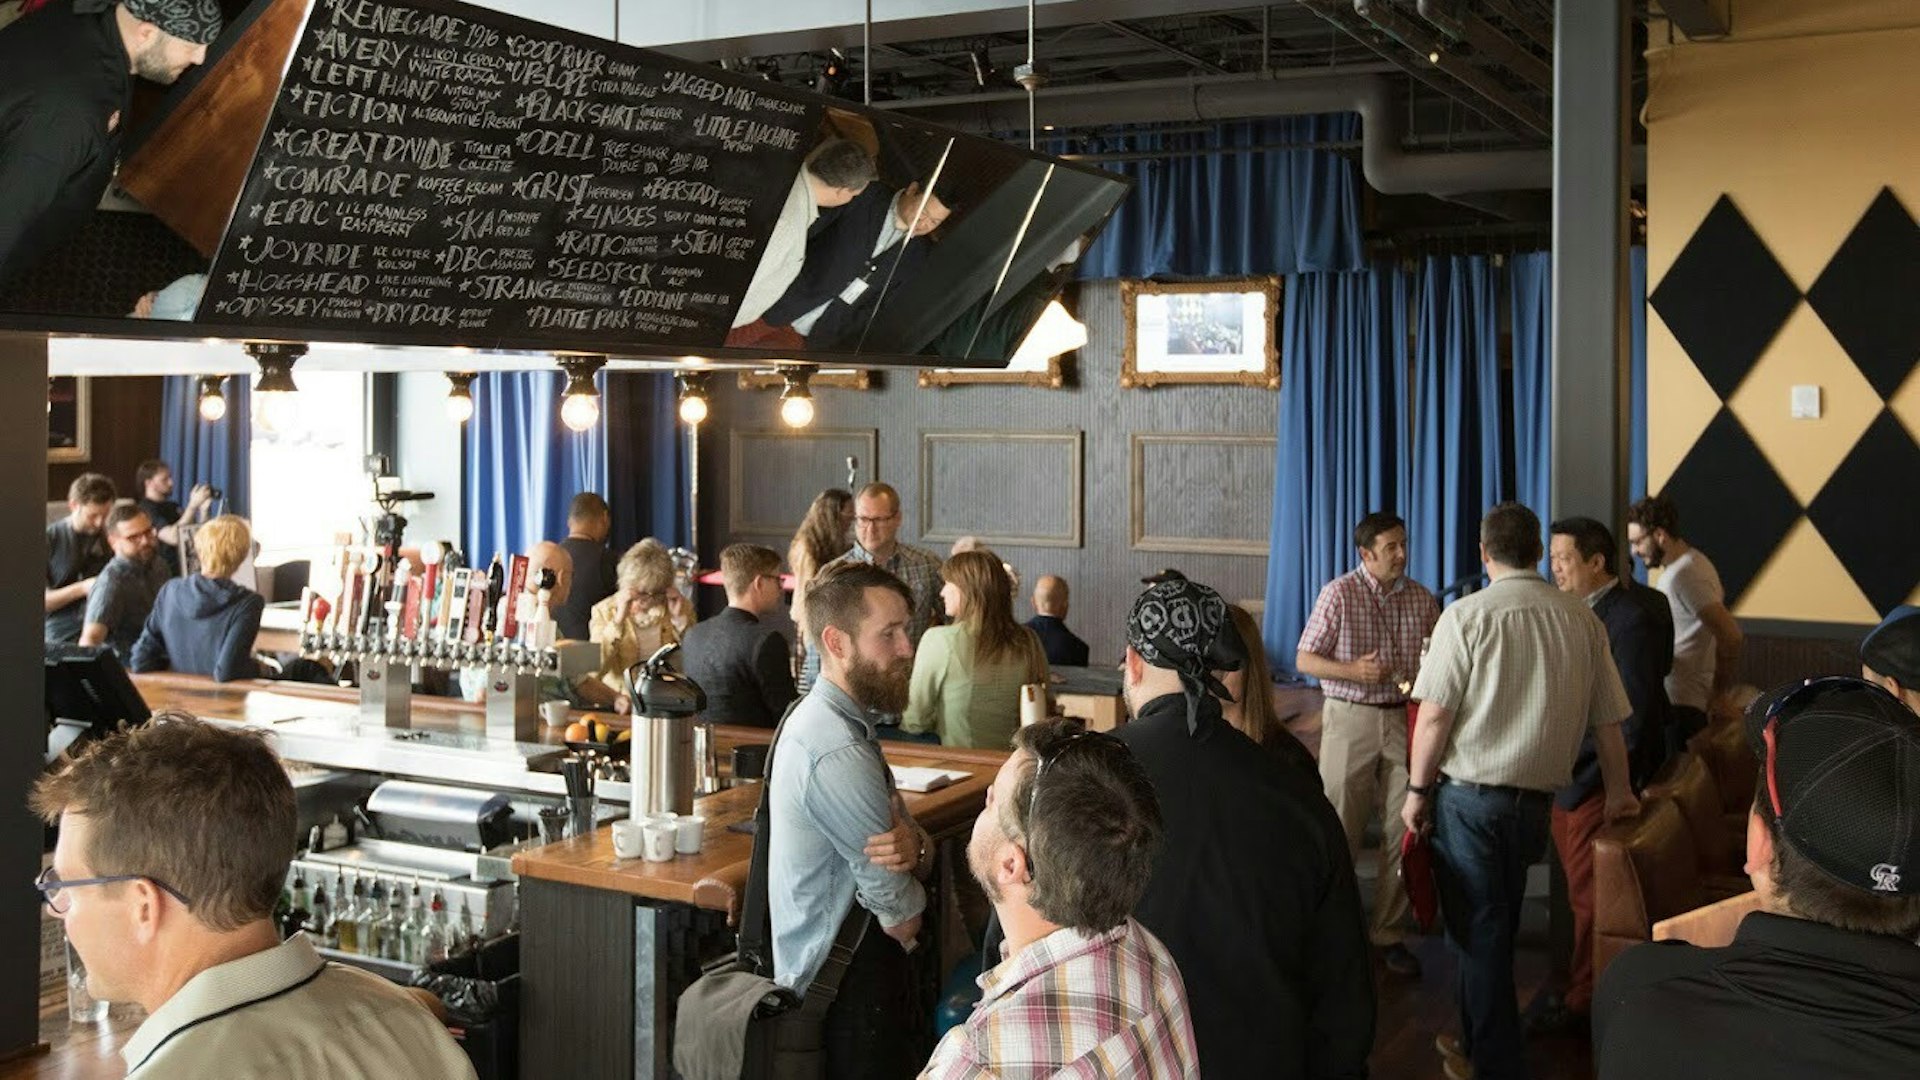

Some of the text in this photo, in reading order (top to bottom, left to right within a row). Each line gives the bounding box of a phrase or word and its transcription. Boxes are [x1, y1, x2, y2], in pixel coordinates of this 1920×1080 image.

[332, 0, 466, 43] RENEGADE
[316, 26, 409, 68] AVERY
[462, 51, 506, 69] KEPOLO
[509, 35, 606, 76] GOOD RIVER
[310, 57, 439, 103] LEFT HAND
[409, 58, 505, 85] WHITE RASCAL
[511, 60, 594, 97] UPSLOPE
[443, 84, 502, 100] NITRO MILK
[662, 71, 757, 111] JAGGED MTN
[303, 89, 406, 125] FICTION
[450, 96, 491, 113] STOUT
[525, 88, 638, 131] BLACK SHIRT
[411, 106, 526, 130] ALTERNATIVE PRESENT
[522, 128, 596, 161] ODELL
[695, 113, 748, 141] LITTLE
[744, 121, 801, 150] MACHINE
[287, 128, 383, 163] GREAT
[463, 140, 491, 155] TITAN
[602, 139, 631, 158] TREE
[629, 143, 671, 161] SHAKER
[458, 158, 516, 172] COLLETTE
[601, 157, 640, 175] DOUBLE
[274, 165, 411, 198] COMRADE
[417, 175, 504, 195] KOFFEE KREAM
[521, 170, 595, 205] GRIST
[263, 197, 330, 226] EPIC
[363, 203, 428, 221] BRAINLESS
[433, 192, 477, 206] STOUT
[340, 215, 417, 238] RASPBERRY
[446, 207, 495, 241] SKA
[494, 225, 532, 237] RED ALE
[243, 236, 367, 269] JOYRIDE
[372, 245, 431, 260] ICE CUTTER
[562, 230, 626, 257] RATIO
[678, 229, 724, 256] STEM
[238, 269, 370, 295] HOGSHEAD
[375, 274, 453, 288] LAKE LIGHTNING
[550, 256, 657, 287] SEEDSTOCK
[381, 286, 433, 299] PALE ALE
[469, 275, 564, 300] STRANGE
[621, 285, 689, 311] EDDYLINE
[226, 296, 326, 317] ODYSSEY
[371, 302, 455, 326] DRY DOCK
[528, 305, 635, 330] PLATTE PARK
